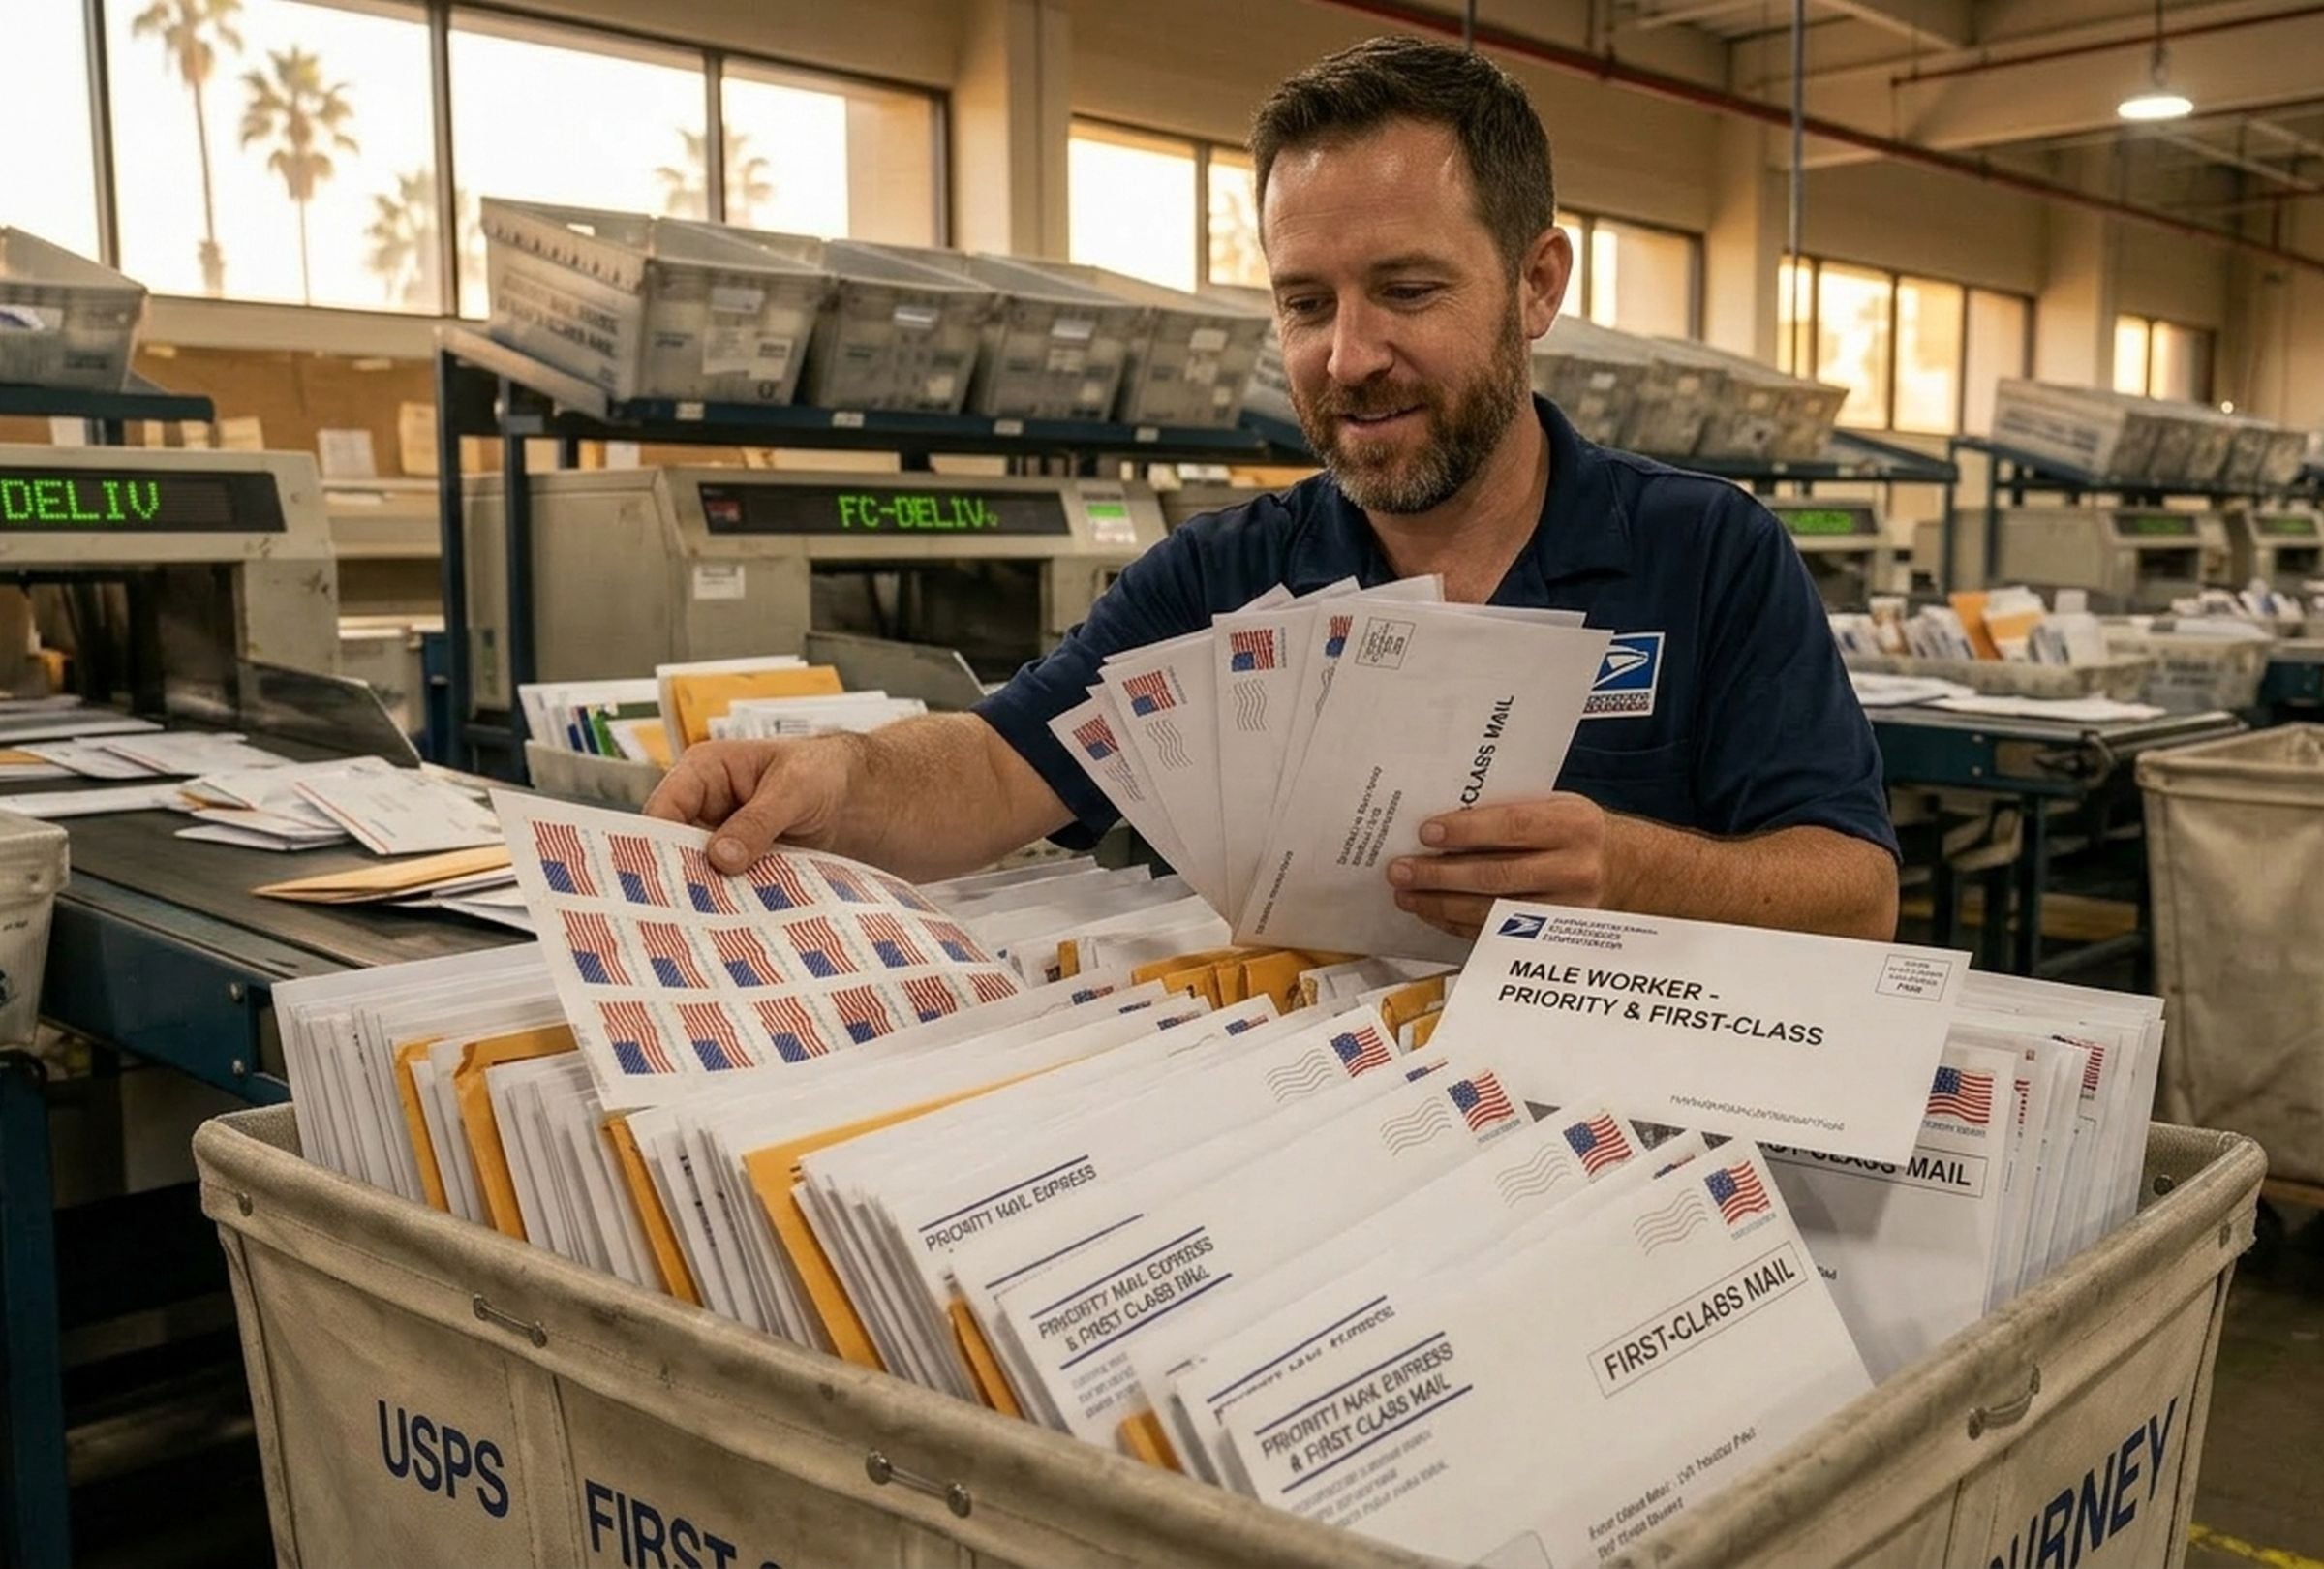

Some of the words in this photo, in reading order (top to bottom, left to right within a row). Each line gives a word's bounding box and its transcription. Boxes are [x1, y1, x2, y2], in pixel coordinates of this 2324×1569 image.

[1, 480, 159, 520] DELIV
[1509, 960, 1581, 985] MALE
[1586, 969, 1703, 1000] WORKER
[1498, 984, 1618, 1016] PRIORITY
[1623, 1001, 1641, 1020] &
[1648, 1004, 1824, 1046] FIRST-CLASS
[1906, 1156, 1972, 1186] MAIL
[1743, 1258, 1795, 1301] MAIL
[378, 1400, 509, 1519] USPS
